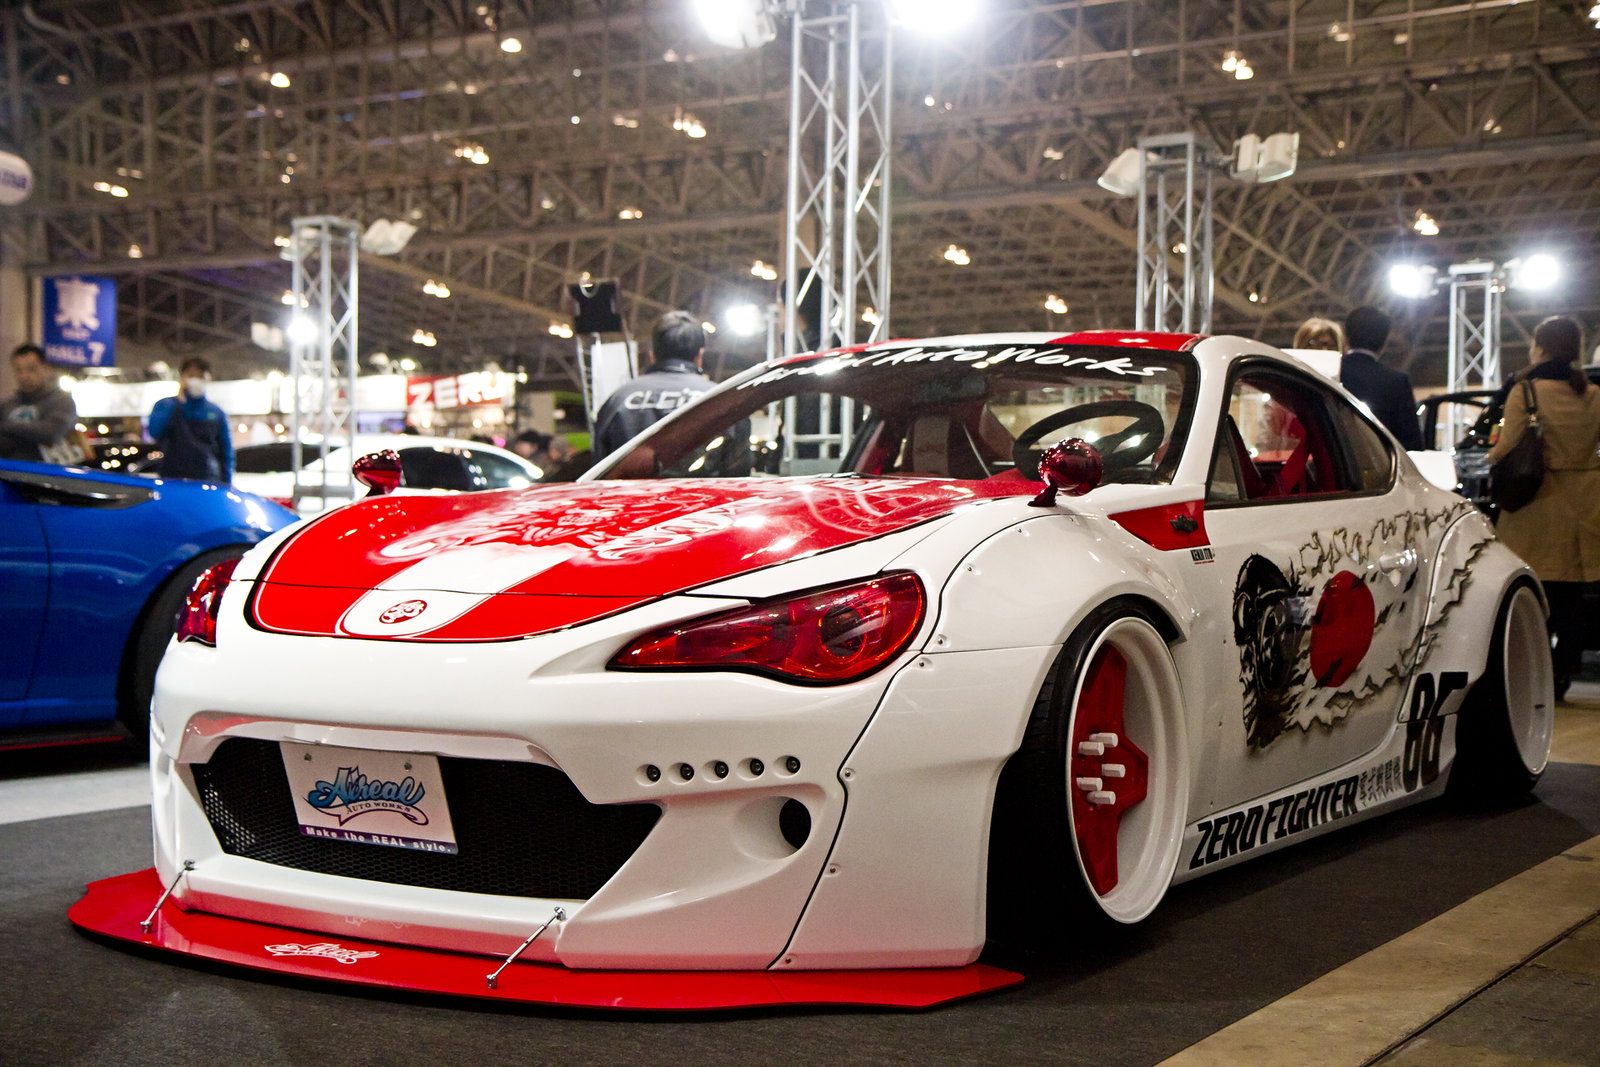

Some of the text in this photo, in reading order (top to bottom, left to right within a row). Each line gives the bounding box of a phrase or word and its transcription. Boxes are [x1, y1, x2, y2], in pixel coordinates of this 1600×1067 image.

[88, 341, 106, 366] 7
[984, 347, 1168, 376] Works
[1403, 671, 1469, 793] 86
[307, 765, 426, 808] Aireal
[346, 801, 412, 815] AUTO WORKS
[1189, 775, 1359, 870] ZERO FIGHTER
[306, 826, 338, 839] Make
[344, 831, 366, 843] the
[372, 834, 407, 848] REAL
